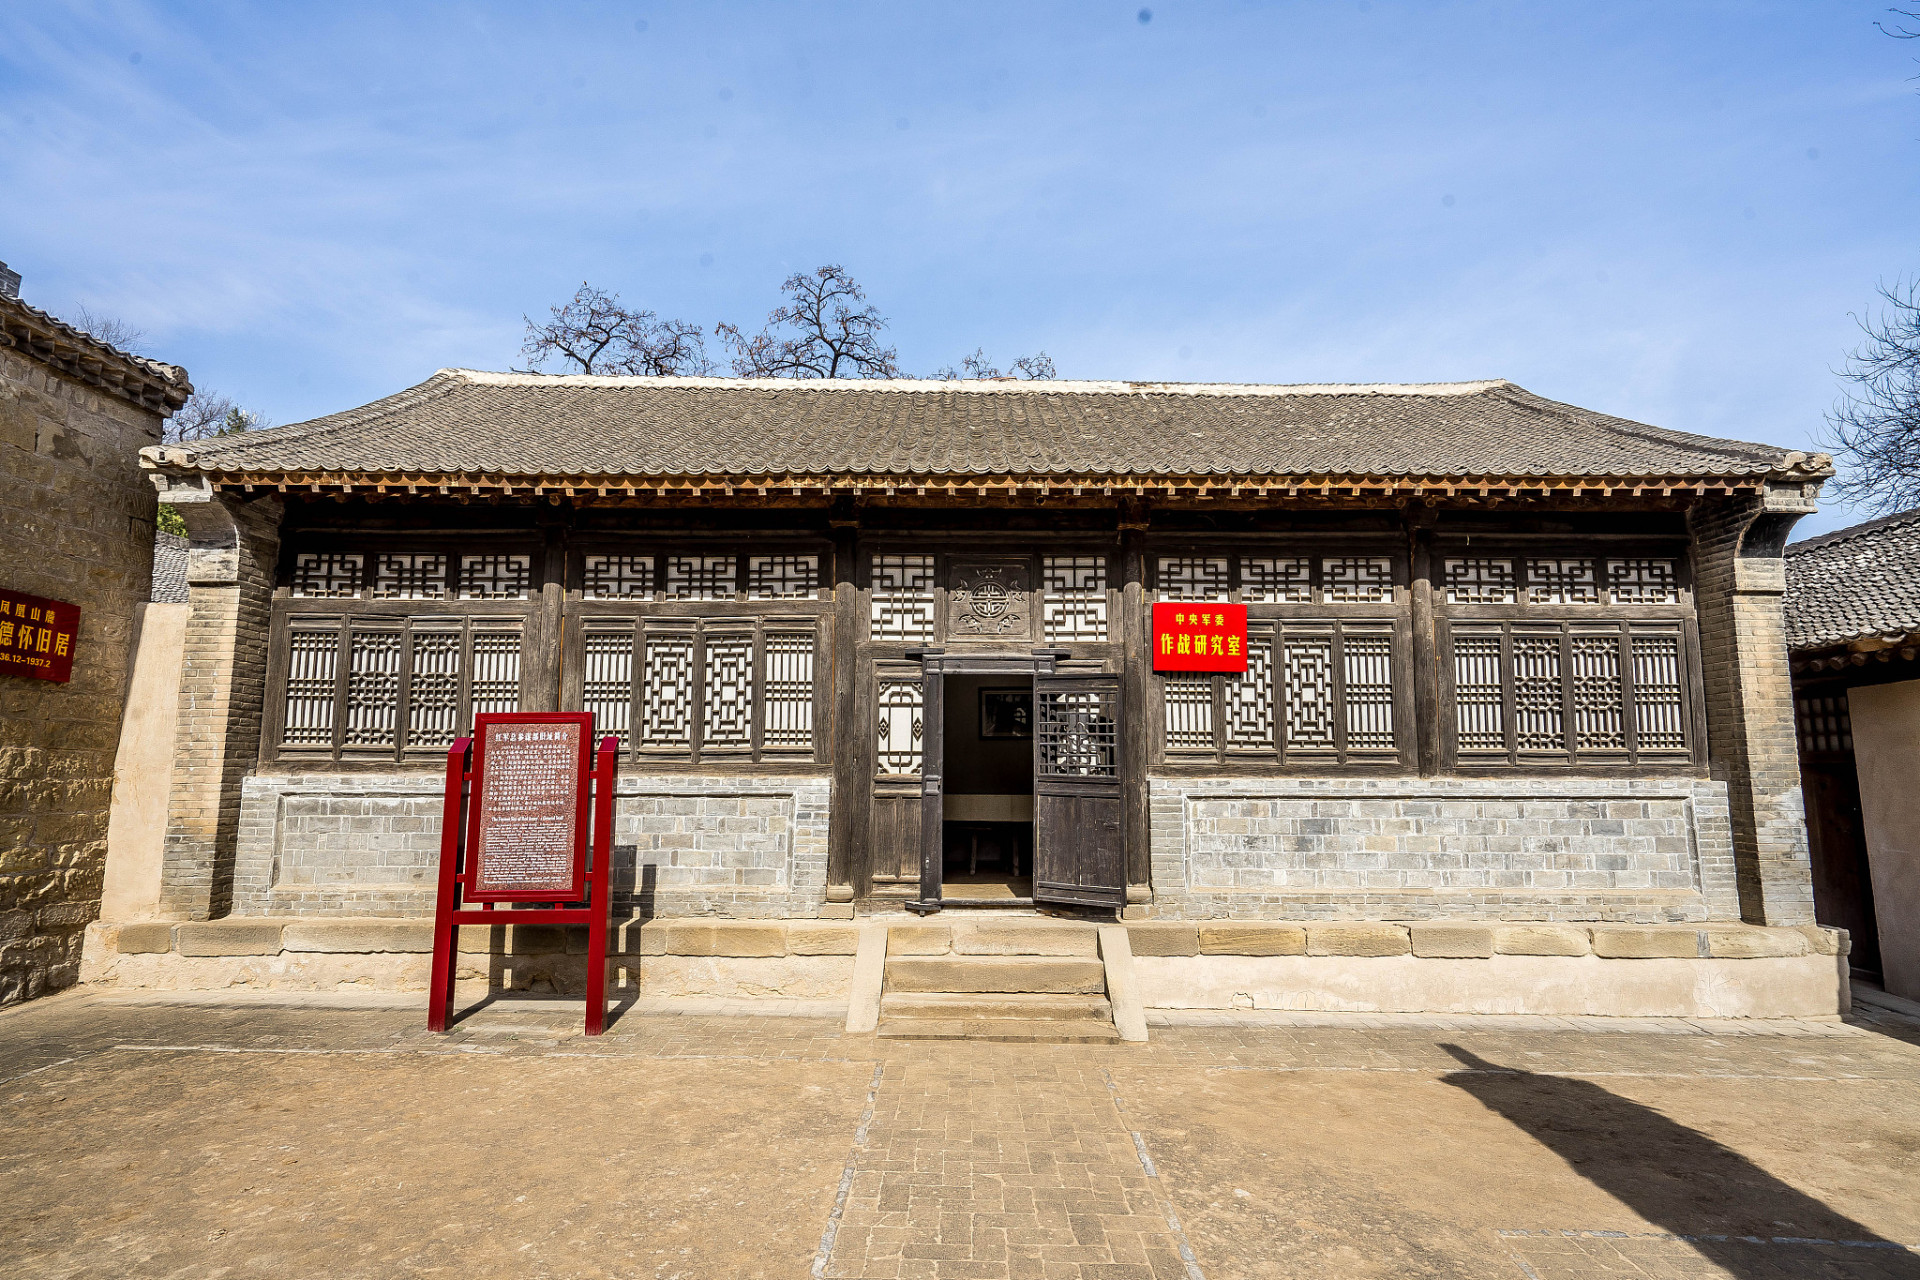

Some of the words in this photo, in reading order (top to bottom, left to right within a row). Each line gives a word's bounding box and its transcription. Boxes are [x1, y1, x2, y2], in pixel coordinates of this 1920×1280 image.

[1175, 613, 1225, 626] 中央军委
[0, 620, 71, 657] 德怀旧居
[1160, 633, 1241, 656] 作战研究室
